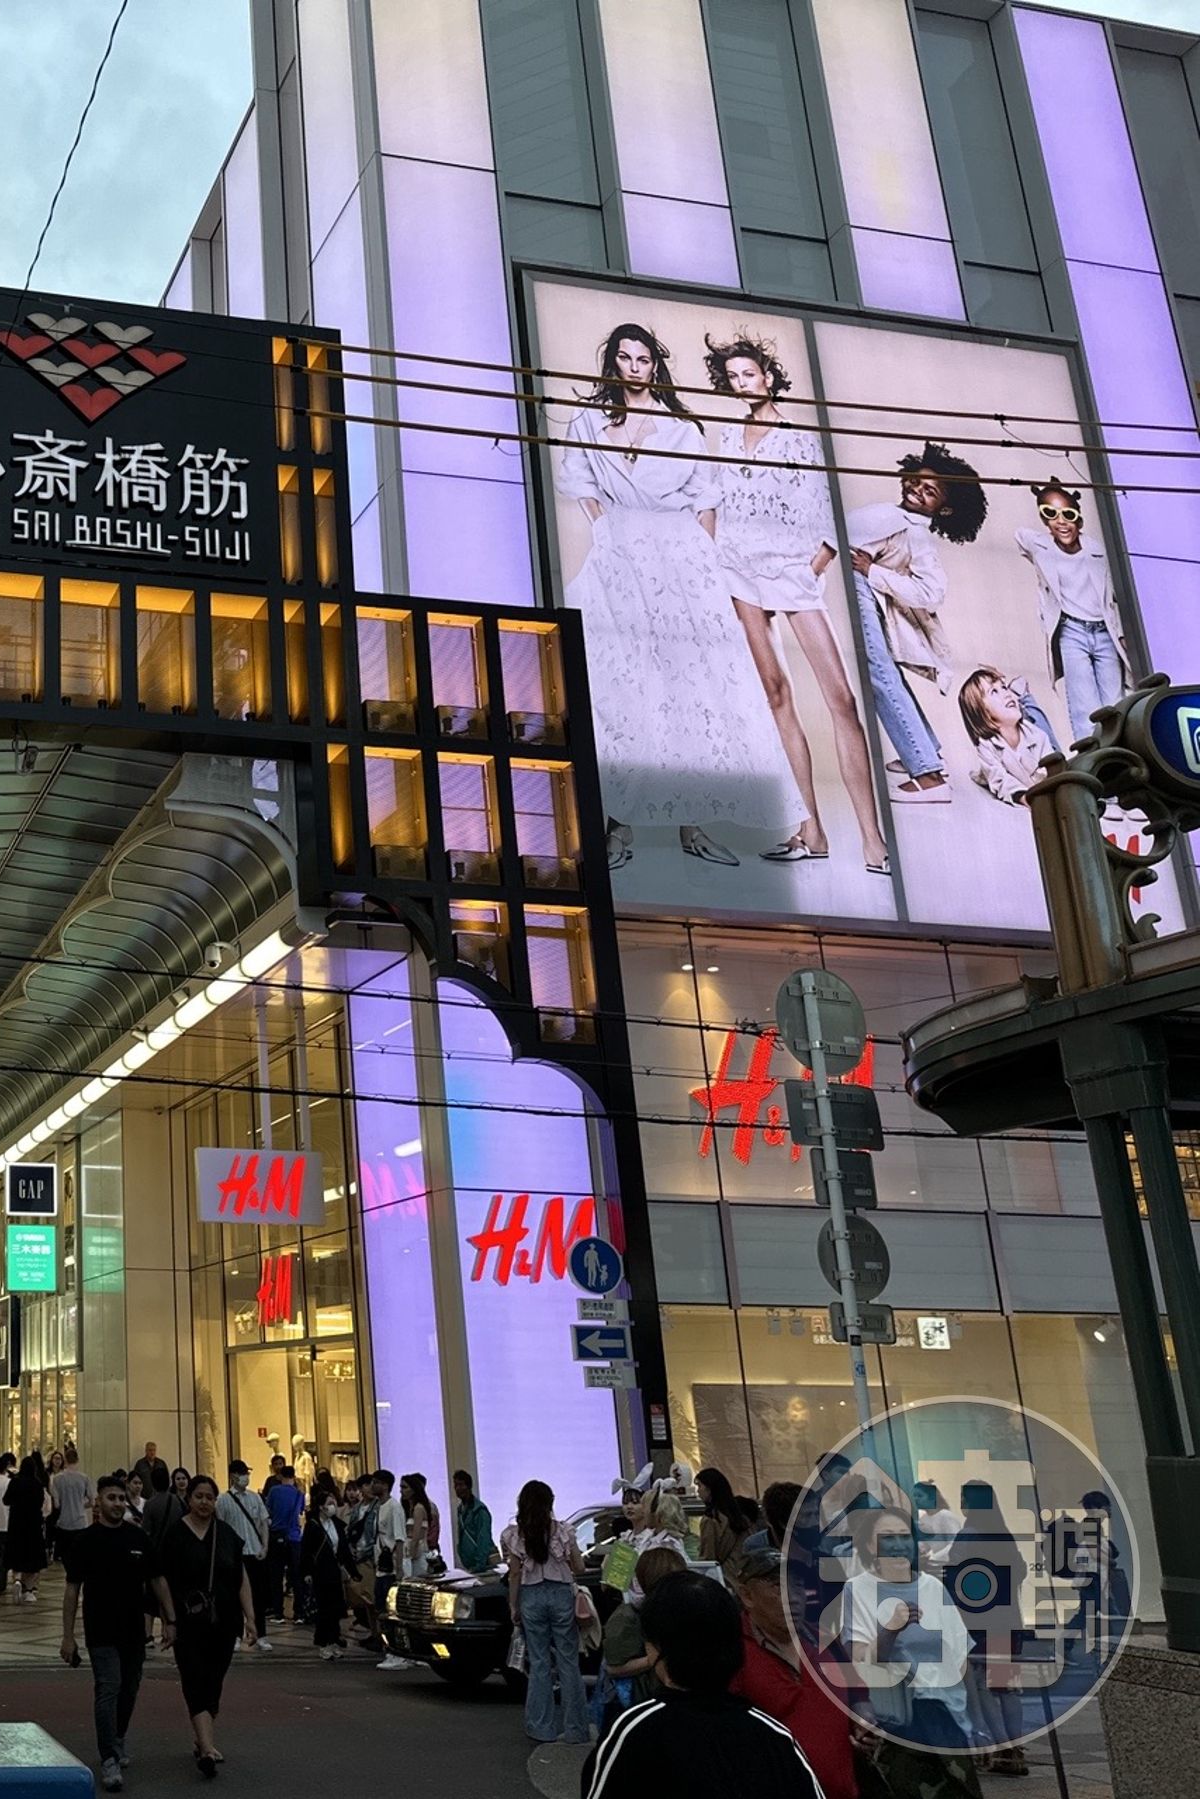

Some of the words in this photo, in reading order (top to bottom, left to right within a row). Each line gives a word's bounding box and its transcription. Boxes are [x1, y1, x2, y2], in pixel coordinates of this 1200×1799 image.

[13, 509, 62, 544] SAI
[18, 1178, 44, 1199] GAP
[216, 1152, 306, 1220] H&M
[465, 1194, 596, 1286] H&M
